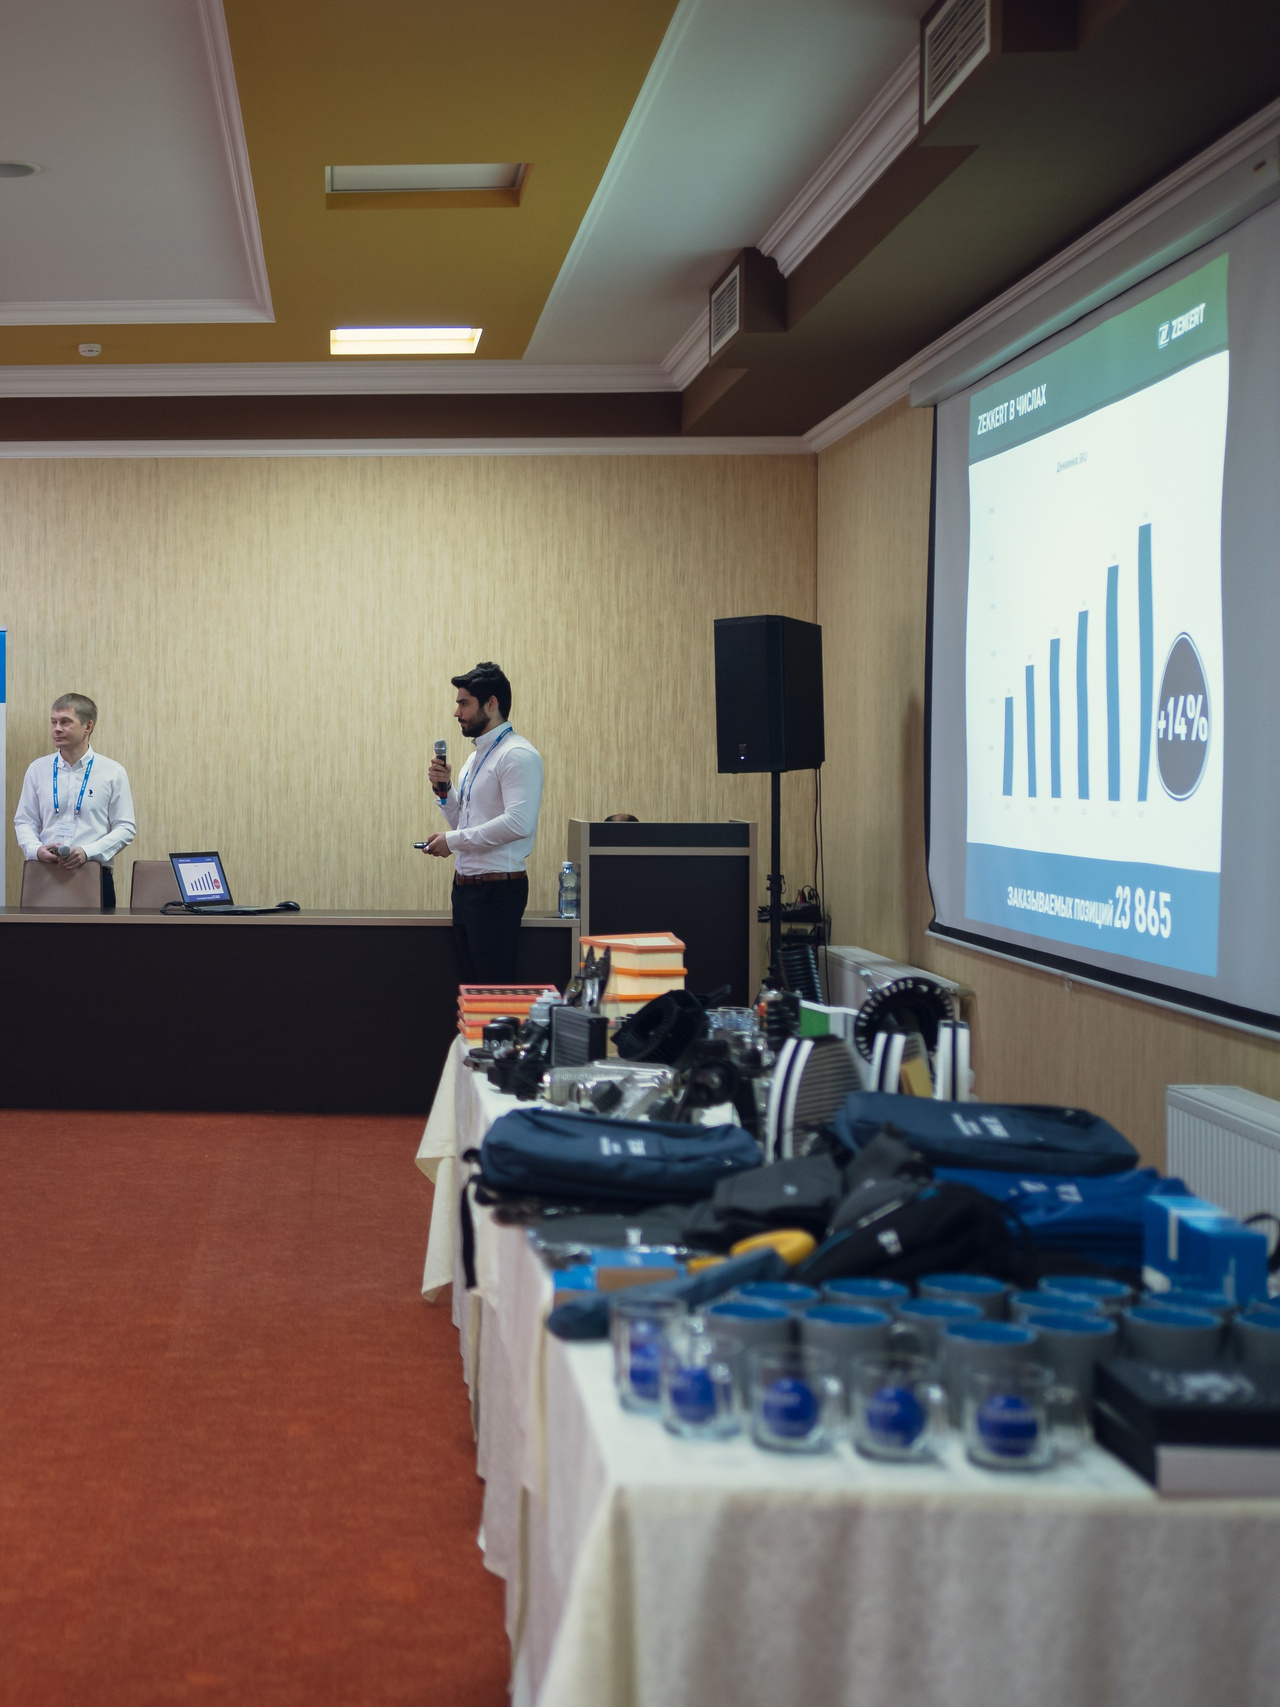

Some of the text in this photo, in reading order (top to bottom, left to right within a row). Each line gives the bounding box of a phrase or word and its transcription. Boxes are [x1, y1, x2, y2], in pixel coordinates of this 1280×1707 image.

[1171, 303, 1206, 340] ZEKKERT
[977, 383, 1047, 435] ZEKKERT В ЧИСЛАХ
[1158, 694, 1208, 742] +14%
[1006, 885, 1172, 939] ЗАКАЗЫВАЕМЫХ ПОЗИЦИЙ 23 865
